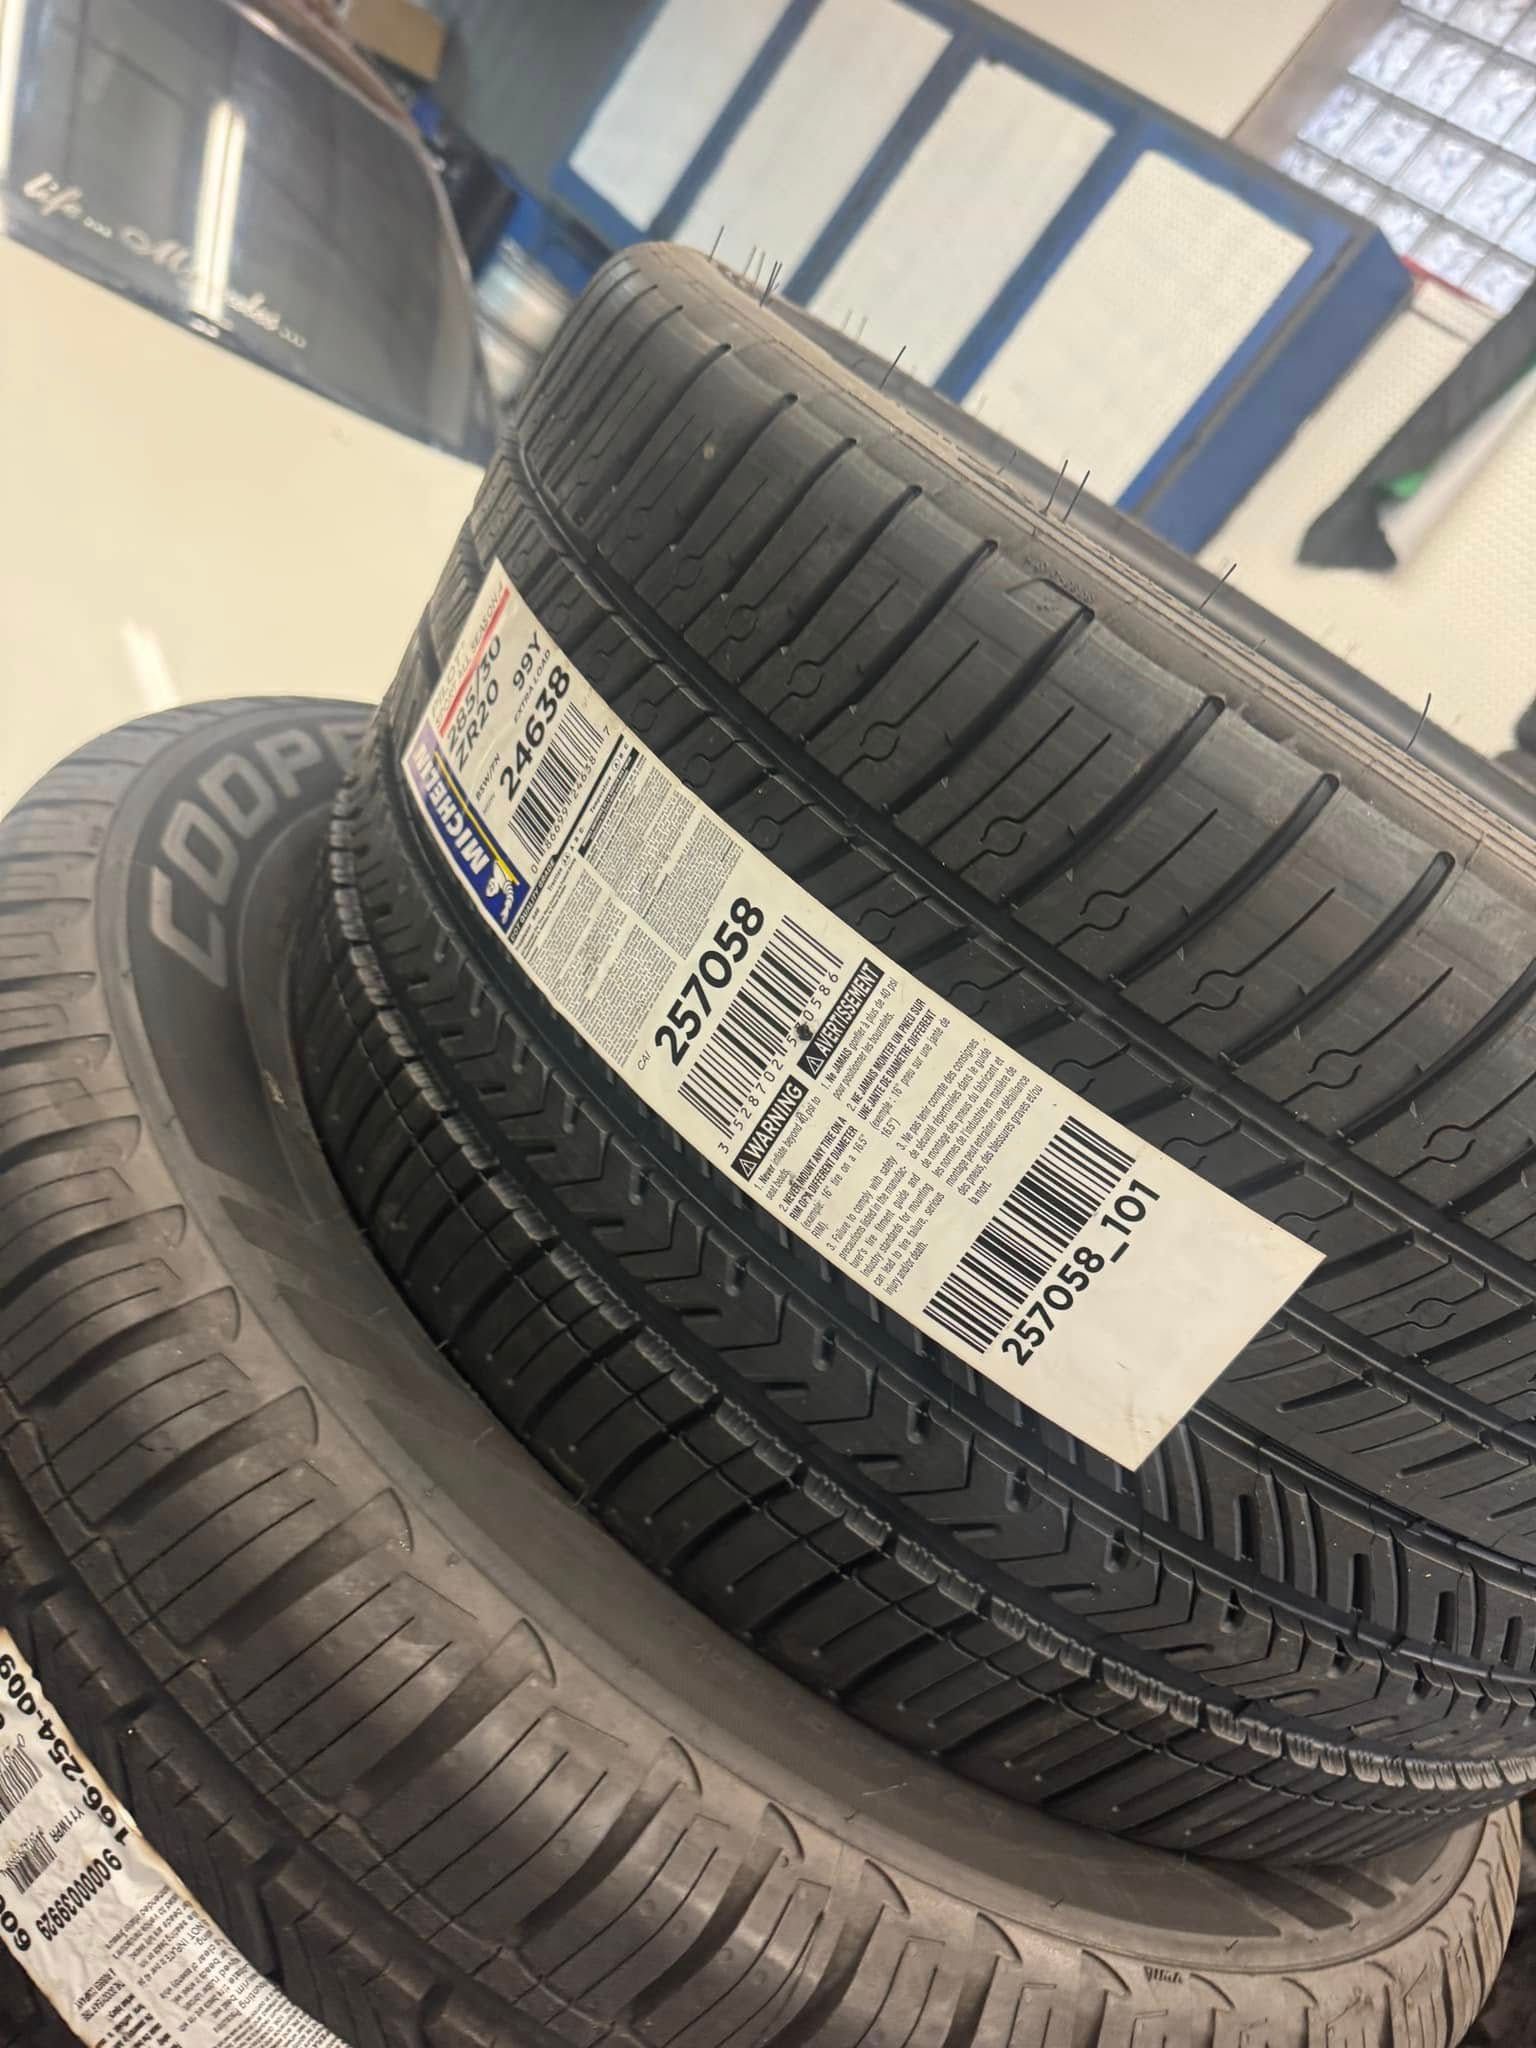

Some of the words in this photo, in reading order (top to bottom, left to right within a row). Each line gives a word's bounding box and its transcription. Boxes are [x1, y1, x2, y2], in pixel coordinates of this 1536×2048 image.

[511, 630, 544, 692] 99Y
[444, 632, 502, 754] 285/30
[512, 683, 533, 723] EXTRA
[531, 647, 551, 684] LOAD
[453, 675, 500, 773] ZR20
[496, 660, 572, 802] 24638
[411, 742, 490, 875] MICHELIN
[530, 863, 538, 875] 0
[569, 753, 596, 799] 24638
[602, 724, 611, 737] 7
[649, 891, 768, 1066] 257058
[885, 976, 900, 992] psi
[873, 996, 884, 1009] de
[878, 987, 891, 1000] 40
[811, 962, 881, 1057] AVERTISSEMENT
[863, 1005, 880, 1024] plus
[860, 1019, 869, 1028] à
[635, 1049, 652, 1071] CAI
[831, 1046, 852, 1074] JAMAIS
[850, 1091, 862, 1104] NE
[856, 1067, 878, 1095] JAMAIS
[872, 1041, 897, 1071] MONTER
[890, 1030, 904, 1044] UN
[898, 1012, 916, 1033] PNEU
[909, 997, 926, 1016] SUR
[900, 1068, 917, 1087] pneu
[911, 1056, 923, 1069] sur
[920, 1043, 932, 1057] une
[926, 1025, 946, 1046] jante
[938, 1015, 950, 1028] de
[950, 1037, 981, 1073] consignes
[972, 1046, 993, 1069] guide
[992, 1055, 1004, 1066] et
[825, 1070, 837, 1083] Ne
[832, 1082, 848, 1101] pour
[840, 1050, 869, 1086] positionner
[861, 1040, 873, 1053] les
[942, 1068, 956, 1084] des
[955, 1071, 973, 1091] dans
[967, 1064, 978, 1075] le
[972, 1063, 998, 1094] fabricant
[717, 1141, 730, 1154] 3
[732, 1058, 783, 1130] 528702
[857, 1103, 872, 1120] UNE
[866, 1083, 885, 1107] JANTE
[879, 1074, 891, 1087] DE
[926, 1080, 950, 1109] compte
[966, 1089, 979, 1103] du
[743, 1081, 803, 1161] WARNING
[836, 1115, 847, 1125] A
[915, 1104, 932, 1122] tenir
[931, 1164, 944, 1177] les
[940, 1143, 960, 1168] normes
[954, 1134, 966, 1145] de
[983, 1098, 994, 1108] en
[1004, 1064, 1016, 1076] de
[954, 1101, 974, 1123] pneus
[758, 1163, 775, 1184] Never
[782, 1122, 804, 1149] beyond
[797, 1113, 808, 1125] 40
[803, 1102, 817, 1117] psi
[810, 1095, 820, 1105] to
[820, 1130, 836, 1149] TIRE
[830, 1120, 843, 1134] ON
[901, 1130, 914, 1143] Ne
[909, 1120, 924, 1135] pas
[944, 1119, 958, 1134] des
[956, 1181, 970, 1195] des
[979, 1149, 994, 1164] des
[987, 1120, 1015, 1152] blessures
[1010, 1101, 1032, 1125] graves
[1024, 1082, 1042, 1103] et/ou
[811, 1144, 827, 1162] ANY
[907, 1147, 920, 1160] de
[925, 1130, 952, 1161] montage
[943, 1157, 970, 1188] montage
[962, 1143, 980, 1162] peut
[993, 1106, 1006, 1121] une
[789, 1205, 803, 1220] RIM
[807, 1157, 835, 1193] DIFFERENT
[830, 1124, 857, 1160] DIAMETER
[796, 1159, 817, 1185] MOUNT
[829, 1172, 843, 1186] tire
[840, 1162, 850, 1173] on
[919, 1156, 932, 1169] de
[763, 1184, 778, 1200] seat
[782, 1181, 802, 1205] NEVER
[831, 1220, 851, 1243] Failure
[845, 1212, 857, 1222] to
[851, 1189, 874, 1215] comply
[867, 1174, 883, 1191] with
[877, 1154, 899, 1177] safety
[875, 1191, 889, 1204] the
[968, 1194, 980, 1205] la
[859, 1208, 877, 1227] listed
[864, 1232, 878, 1246] tire
[891, 1187, 911, 1210] guide
[905, 1172, 920, 1188] and
[871, 1201, 881, 1211] in
[877, 1221, 904, 1253] standards
[898, 1211, 911, 1223] for
[906, 1181, 934, 1214] mounting
[837, 1224, 867, 1261] precautions
[873, 1273, 886, 1287] can
[881, 1258, 896, 1273] lead
[891, 1249, 902, 1259] to
[897, 1237, 911, 1250] tire
[922, 1190, 944, 1216] serious
[895, 1257, 915, 1279] and/or
[996, 1178, 1164, 1367] 257058_101
[0, 1652, 131, 1847] 166-254-009
[34, 1846, 123, 1942] 90000039929
